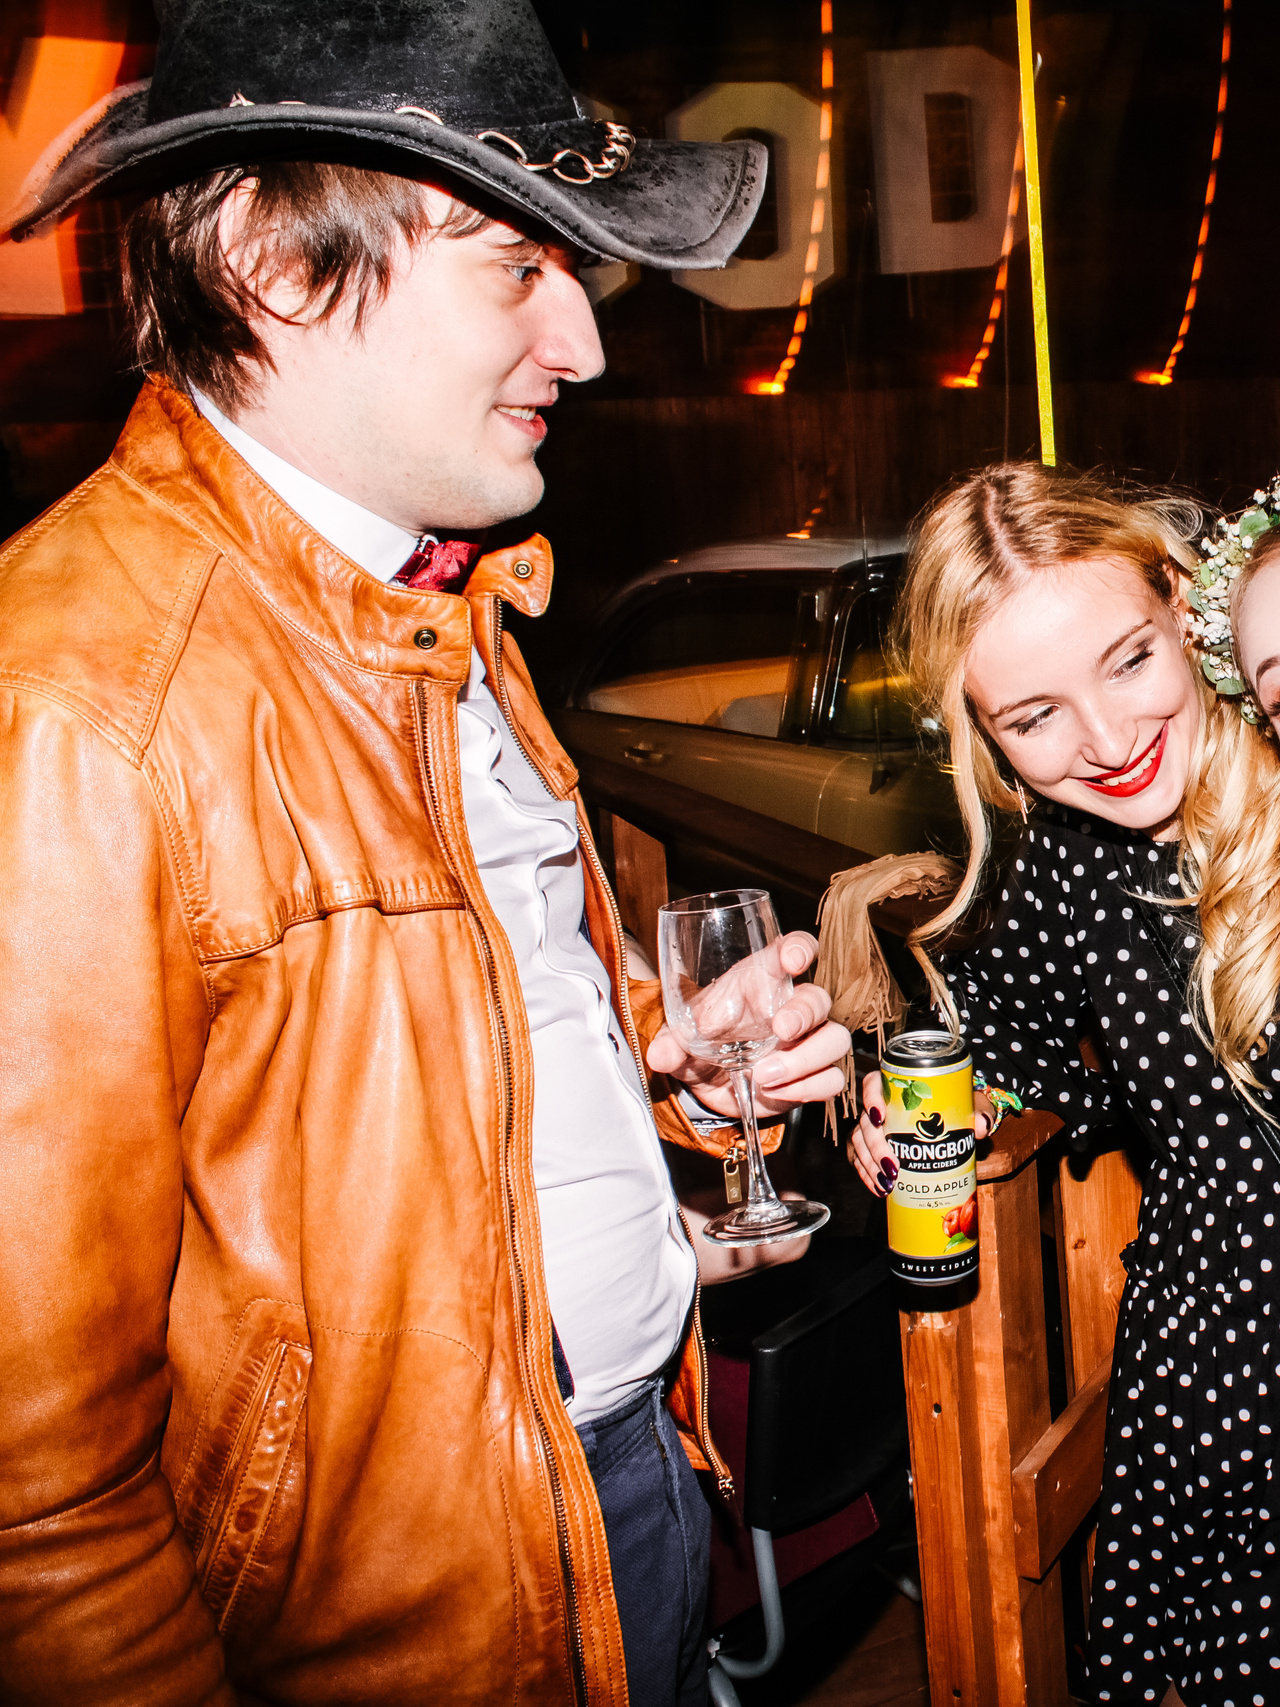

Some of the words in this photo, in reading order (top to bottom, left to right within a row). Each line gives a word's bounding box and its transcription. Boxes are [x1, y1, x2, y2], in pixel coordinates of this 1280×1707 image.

[908, 1161, 931, 1170] APPLE
[932, 1159, 958, 1169] CIDERS
[897, 1181, 930, 1194] GOLD
[933, 1176, 969, 1194] APPLE
[901, 1262, 935, 1272] SWEET
